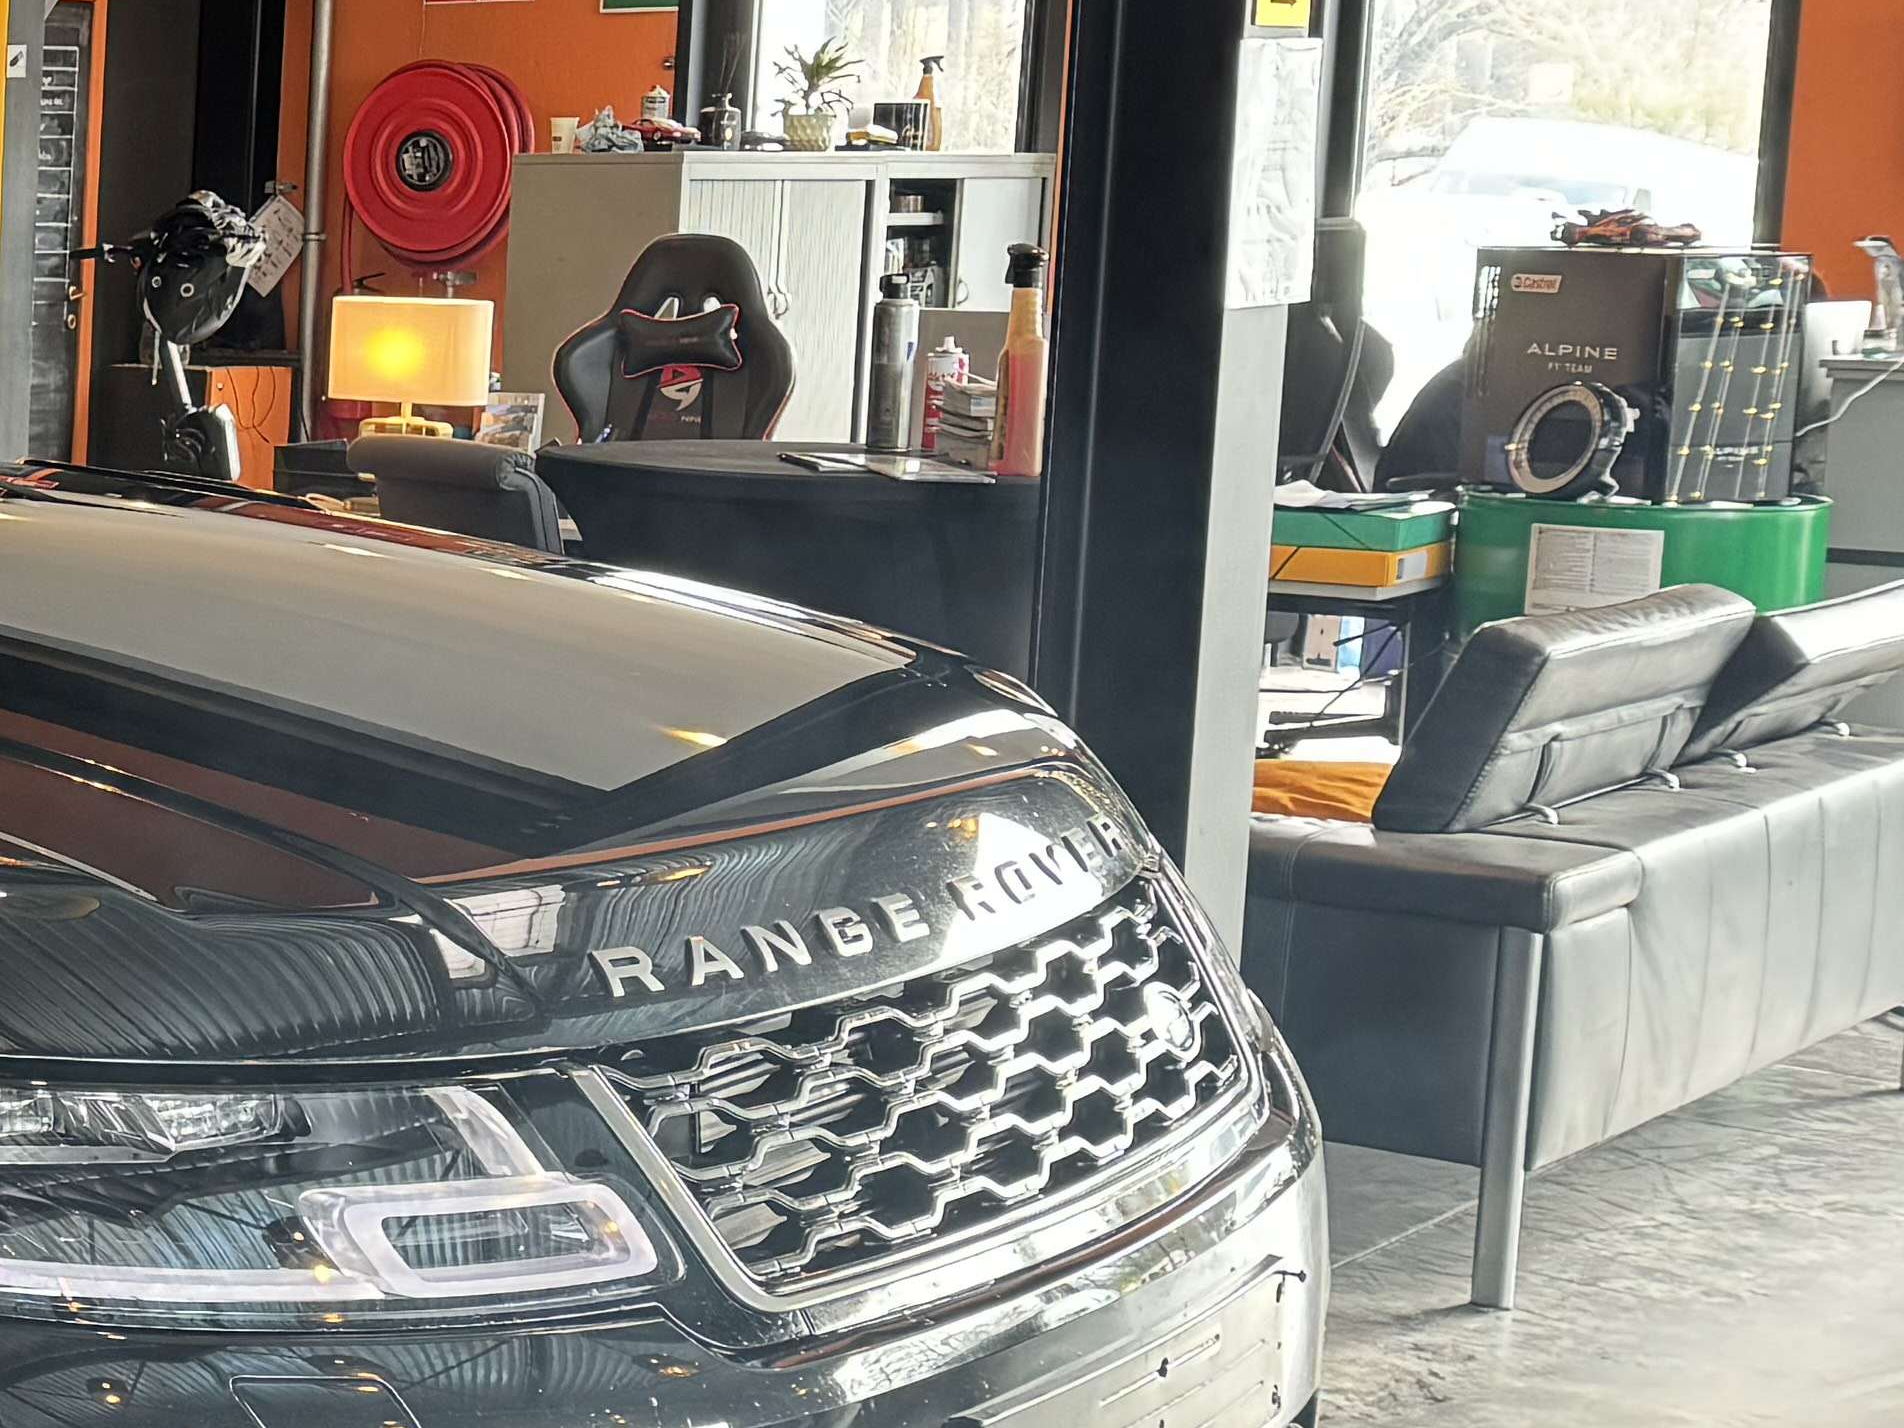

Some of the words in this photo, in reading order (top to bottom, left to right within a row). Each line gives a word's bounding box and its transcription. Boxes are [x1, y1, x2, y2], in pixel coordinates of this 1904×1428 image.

[1527, 342, 1618, 360] ALPINE
[1565, 363, 1593, 374] TEAM
[591, 892, 930, 998] RANGE
[946, 811, 1123, 921] ROVER
